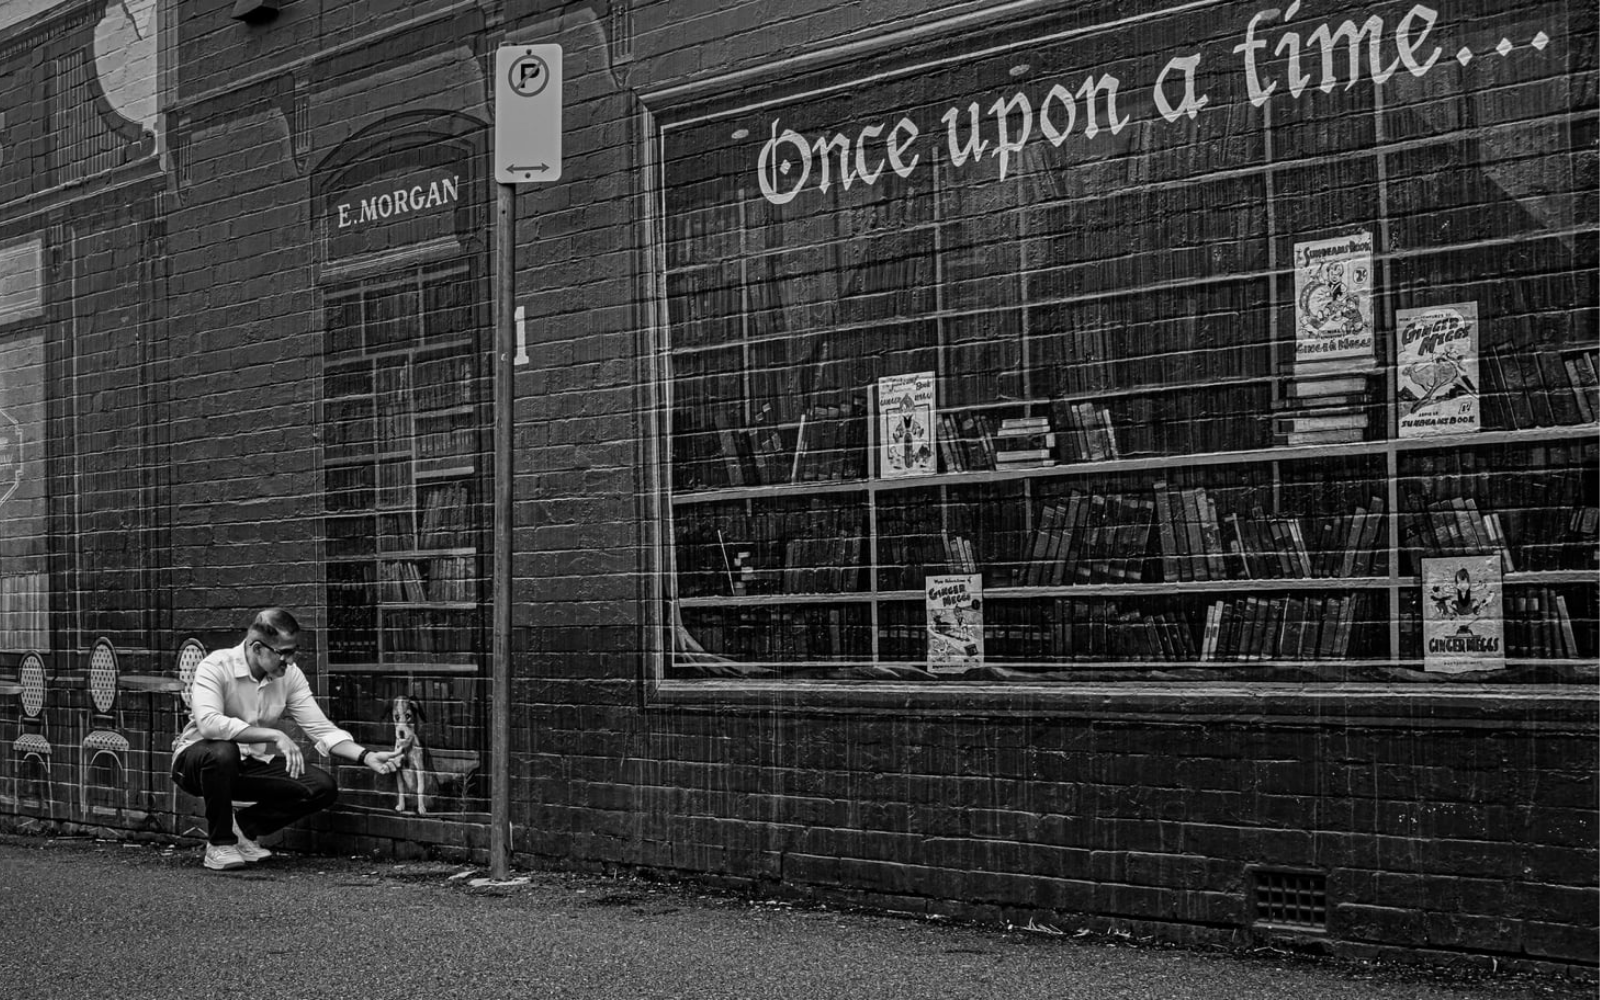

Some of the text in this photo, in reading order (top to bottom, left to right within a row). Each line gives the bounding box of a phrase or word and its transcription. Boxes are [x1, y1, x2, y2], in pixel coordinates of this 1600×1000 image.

[757, 118, 919, 205] Once
[941, 73, 1130, 183] upon
[1153, 53, 1208, 123] a
[929, 584, 966, 601] GINGER
[1429, 637, 1466, 653] GINGER
